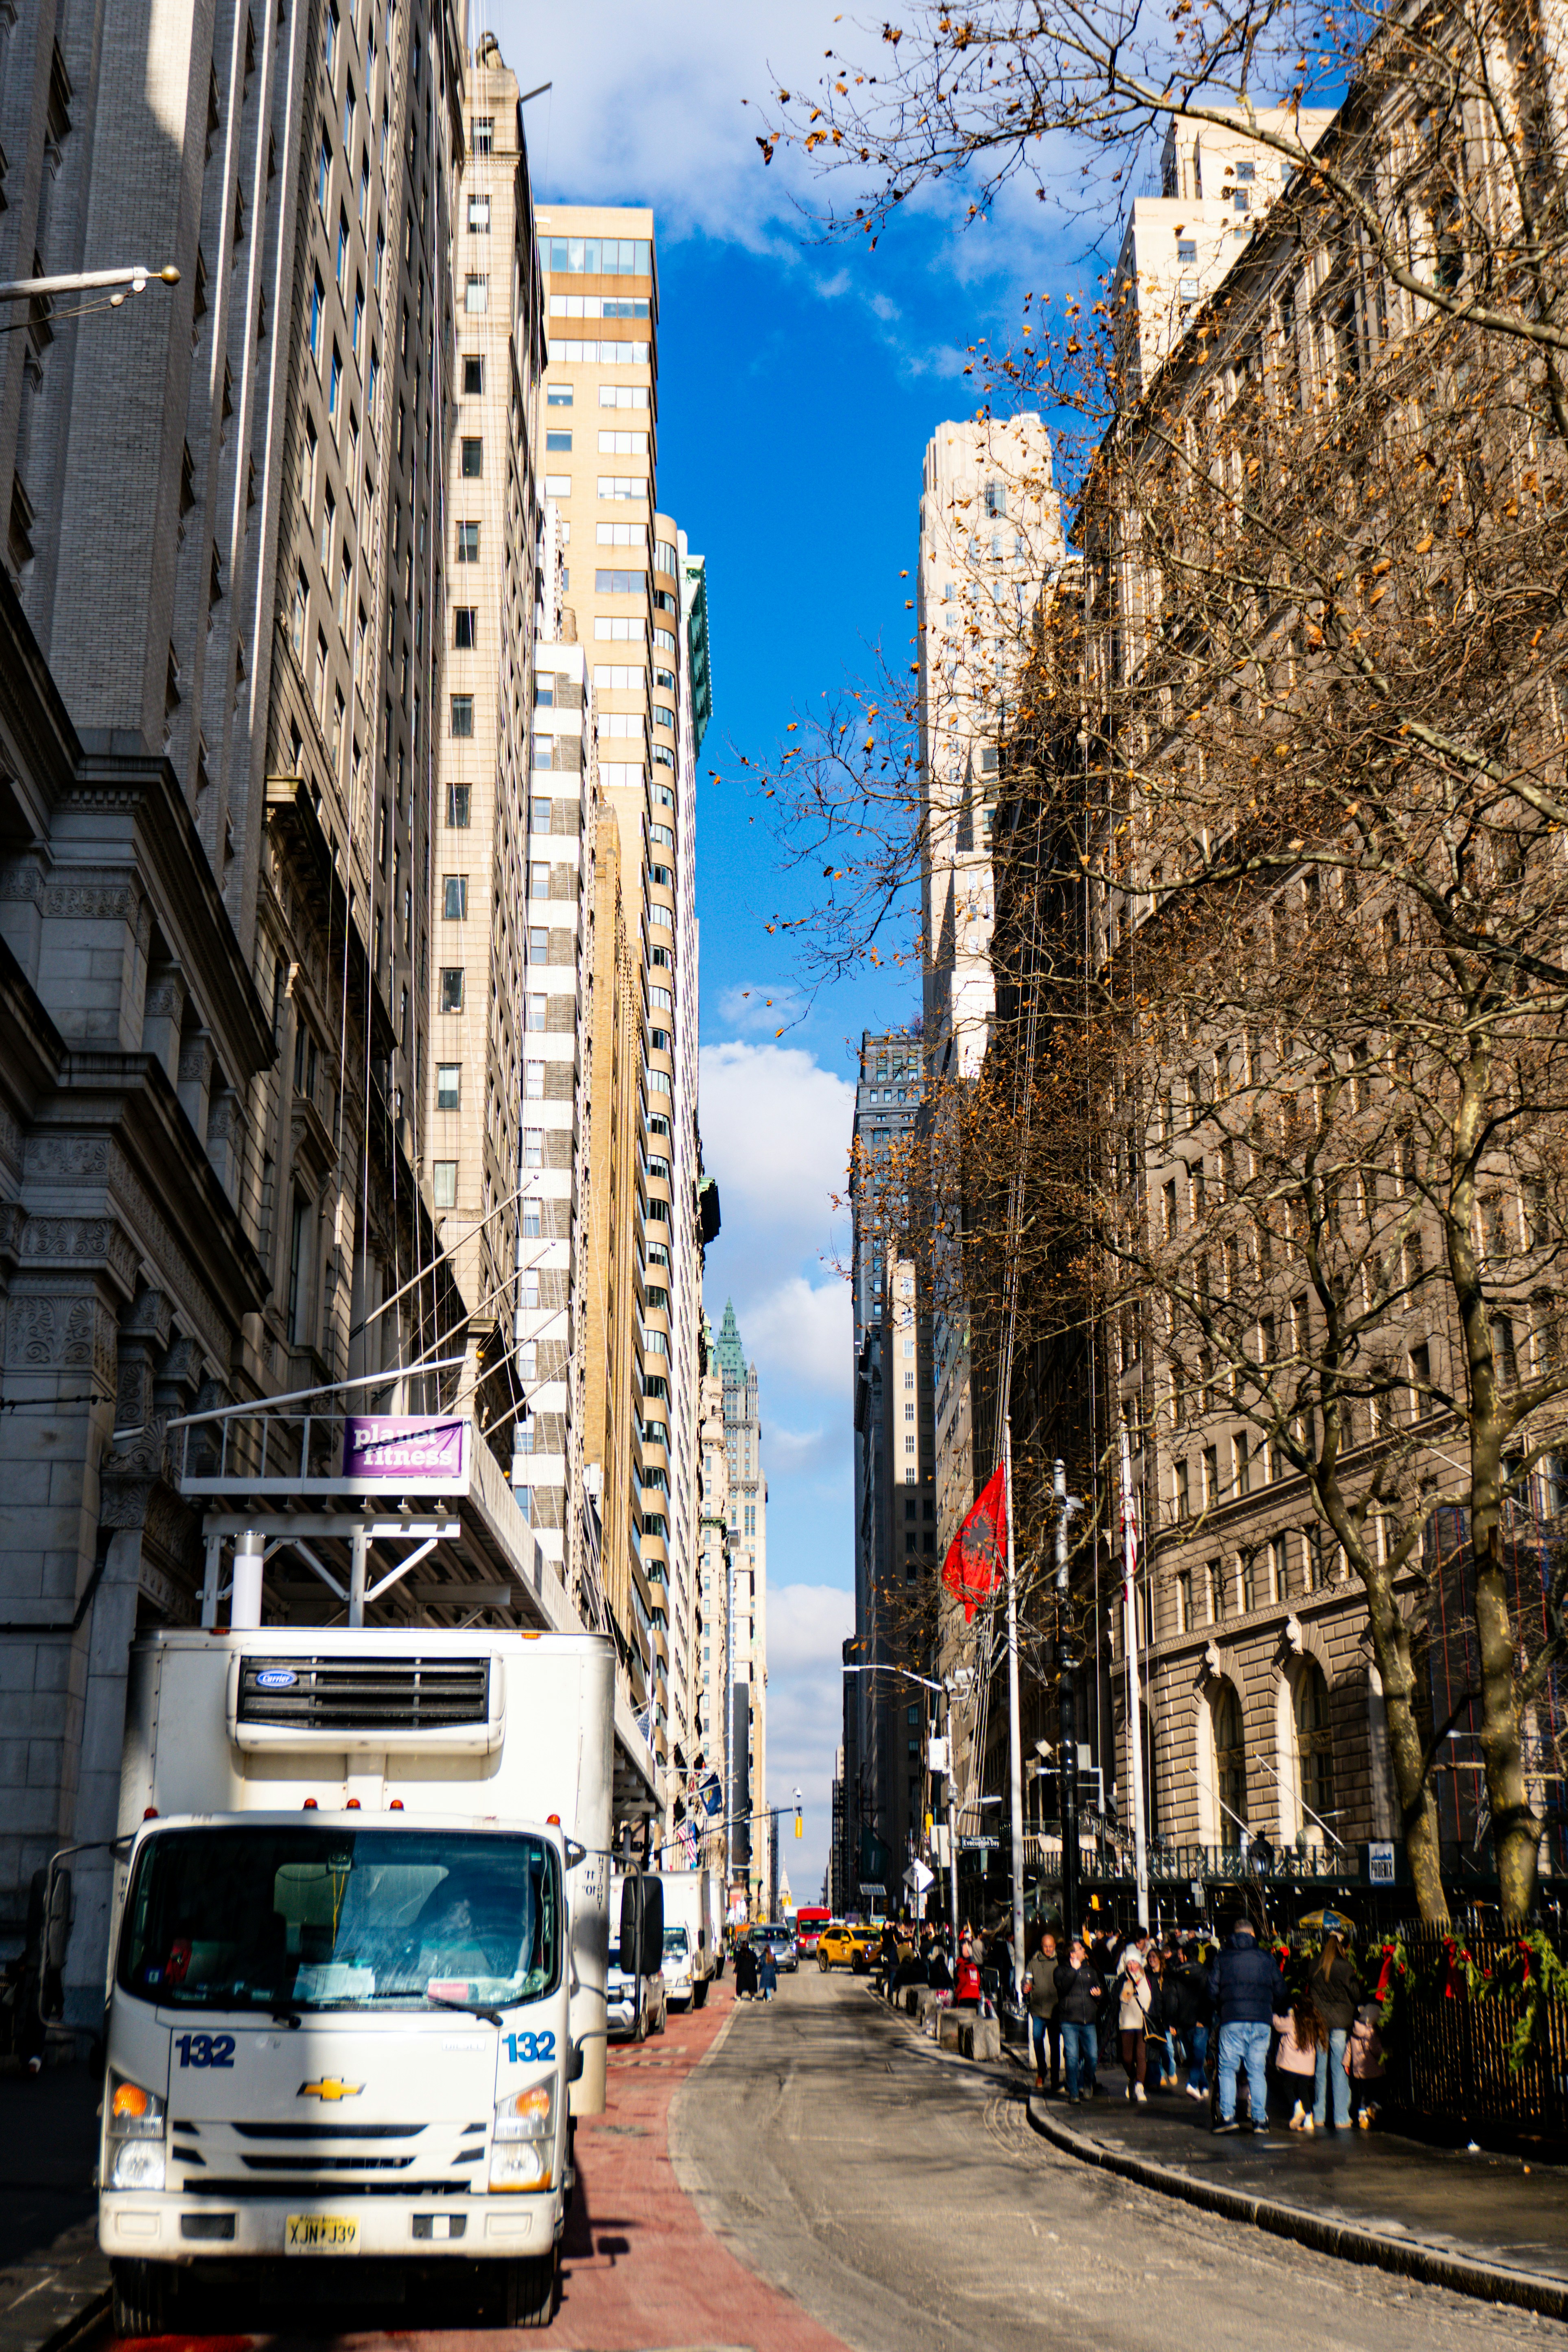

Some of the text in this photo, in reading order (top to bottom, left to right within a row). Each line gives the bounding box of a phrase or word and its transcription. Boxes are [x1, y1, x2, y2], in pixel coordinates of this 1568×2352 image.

[353, 1424, 437, 1449] planet
[363, 1445, 453, 1465] fitness
[262, 1674, 291, 1683] Carrier
[991, 1839, 1000, 1848] Day
[1371, 1861, 1393, 1878] PHOENIX
[175, 2034, 235, 2068] 132
[502, 2031, 555, 2062] 132
